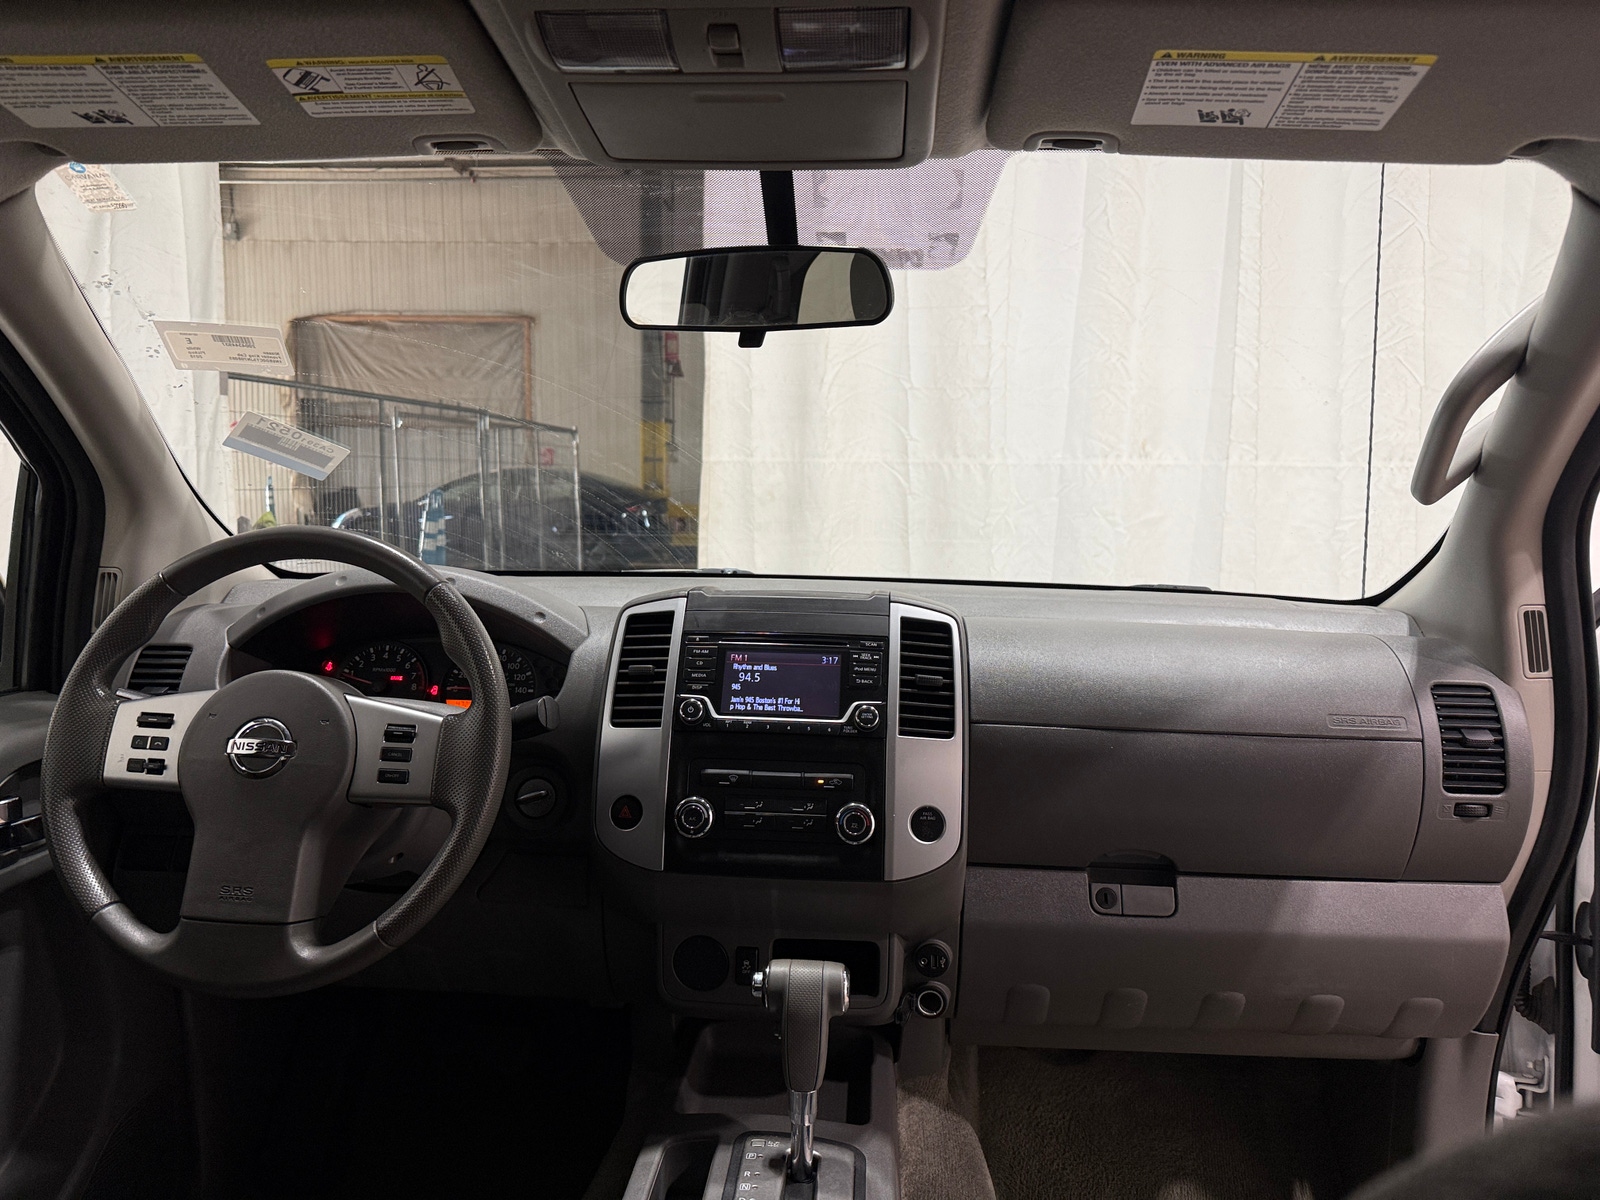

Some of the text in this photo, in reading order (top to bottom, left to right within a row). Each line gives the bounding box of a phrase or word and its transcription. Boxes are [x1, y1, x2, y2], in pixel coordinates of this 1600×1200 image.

[730, 653, 748, 662] FM 1
[821, 656, 839, 665] 3:17
[359, 660, 364, 668] 2
[405, 661, 411, 669] 6
[507, 662, 520, 670] 100
[732, 663, 752, 671] Rhythm
[513, 673, 526, 681] 120
[738, 672, 761, 682] 94.5
[735, 703, 746, 711] Hop
[1332, 716, 1402, 726] SRS AIRBAG
[233, 741, 288, 753] NISSAN
[220, 885, 255, 895] SRS
